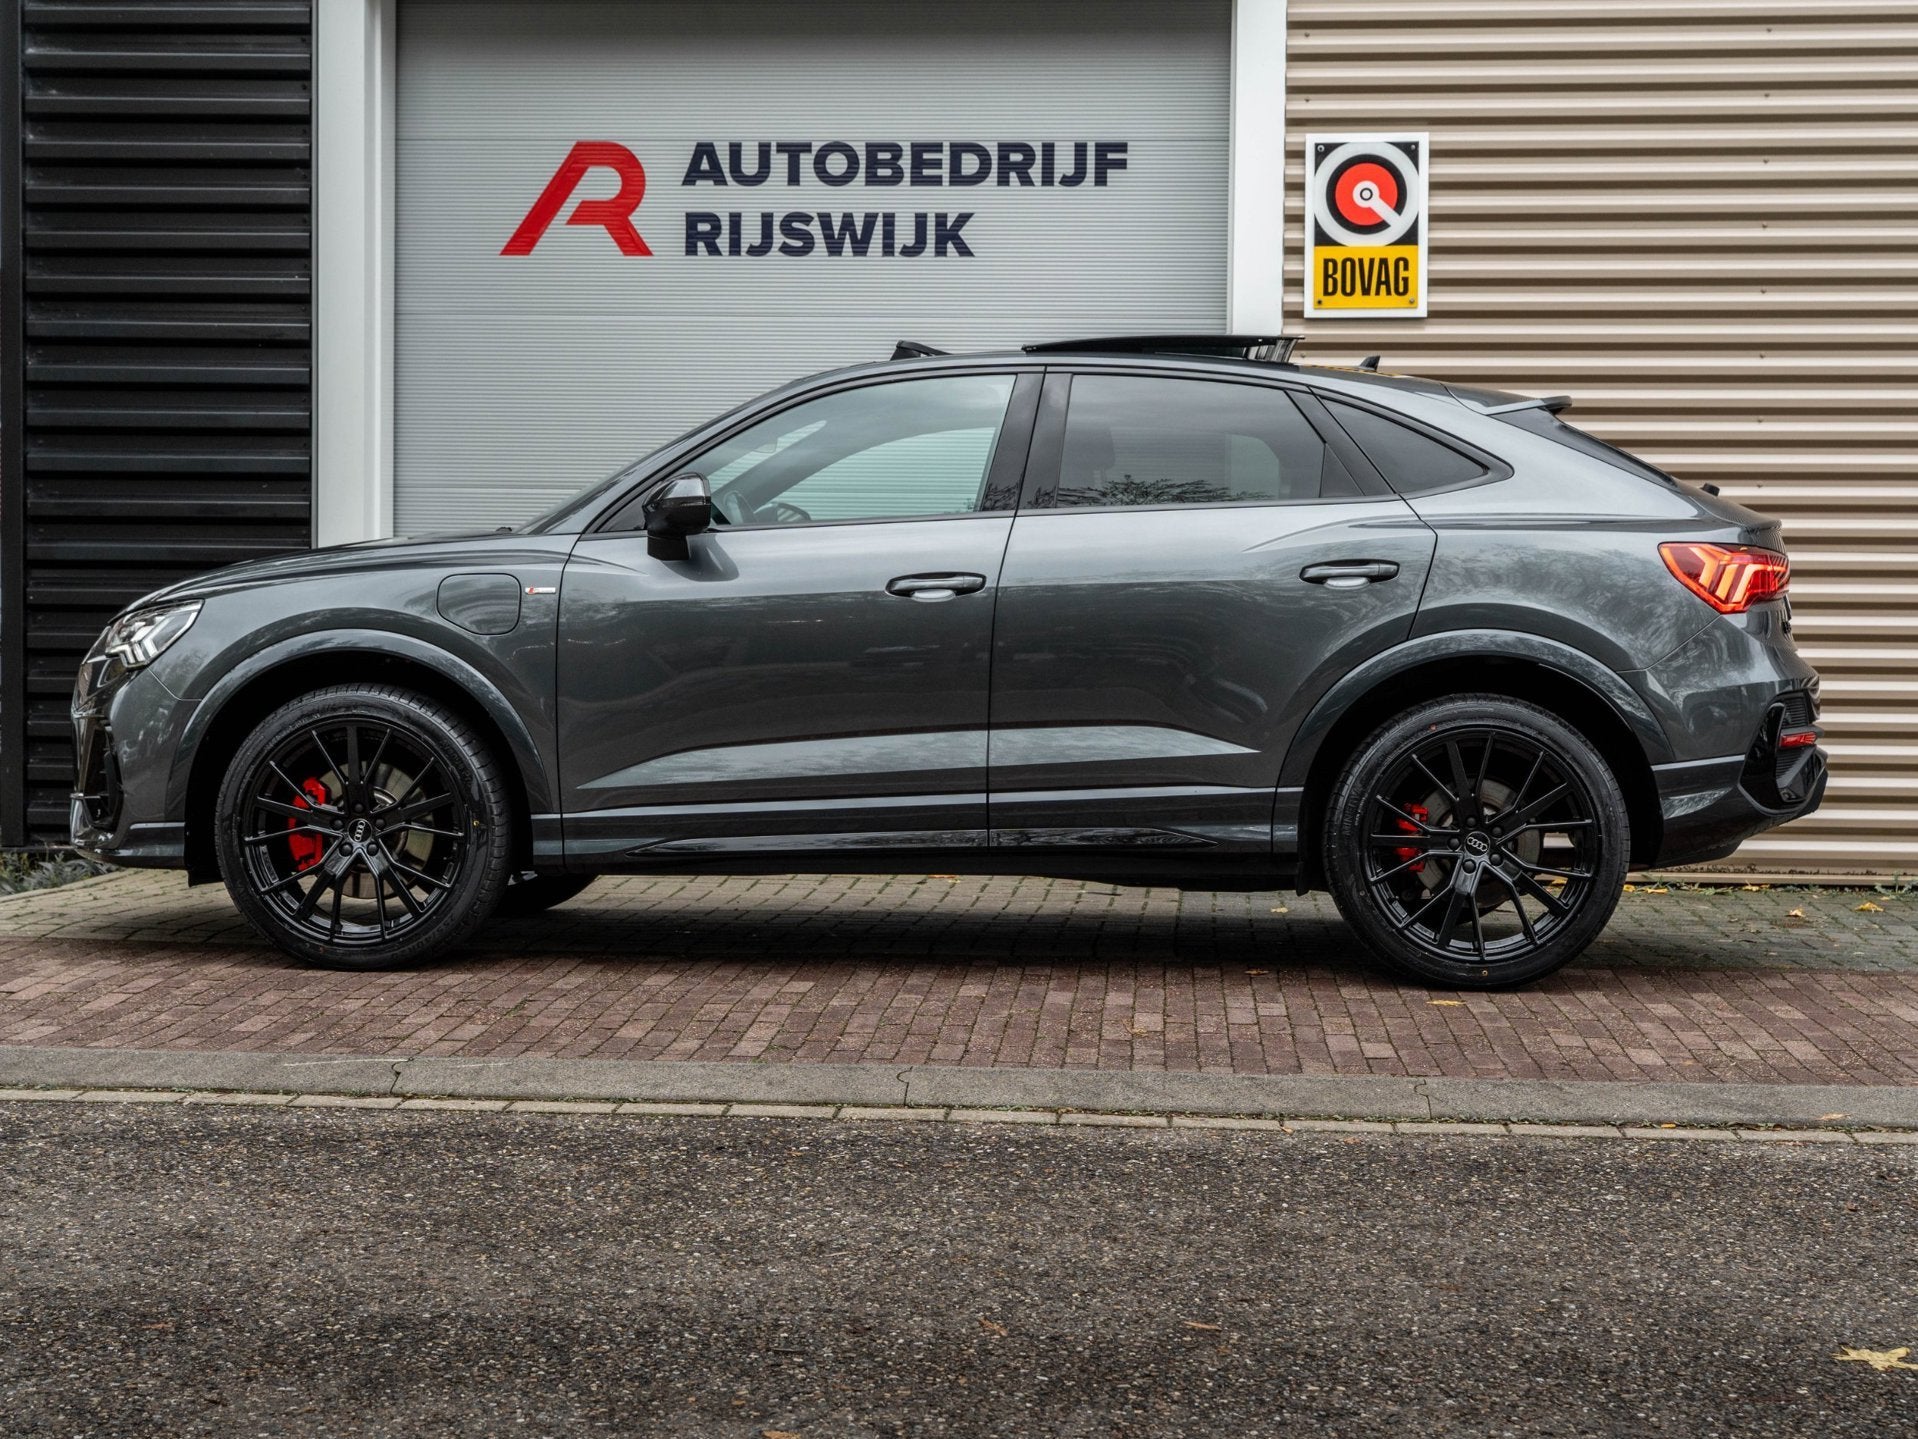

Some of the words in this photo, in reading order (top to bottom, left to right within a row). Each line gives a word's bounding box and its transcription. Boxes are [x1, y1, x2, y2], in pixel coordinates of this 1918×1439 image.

[682, 141, 1128, 187] AUTOBEDRIJF
[685, 212, 974, 257] RIJSWIJK
[1322, 257, 1409, 297] BOVAG
